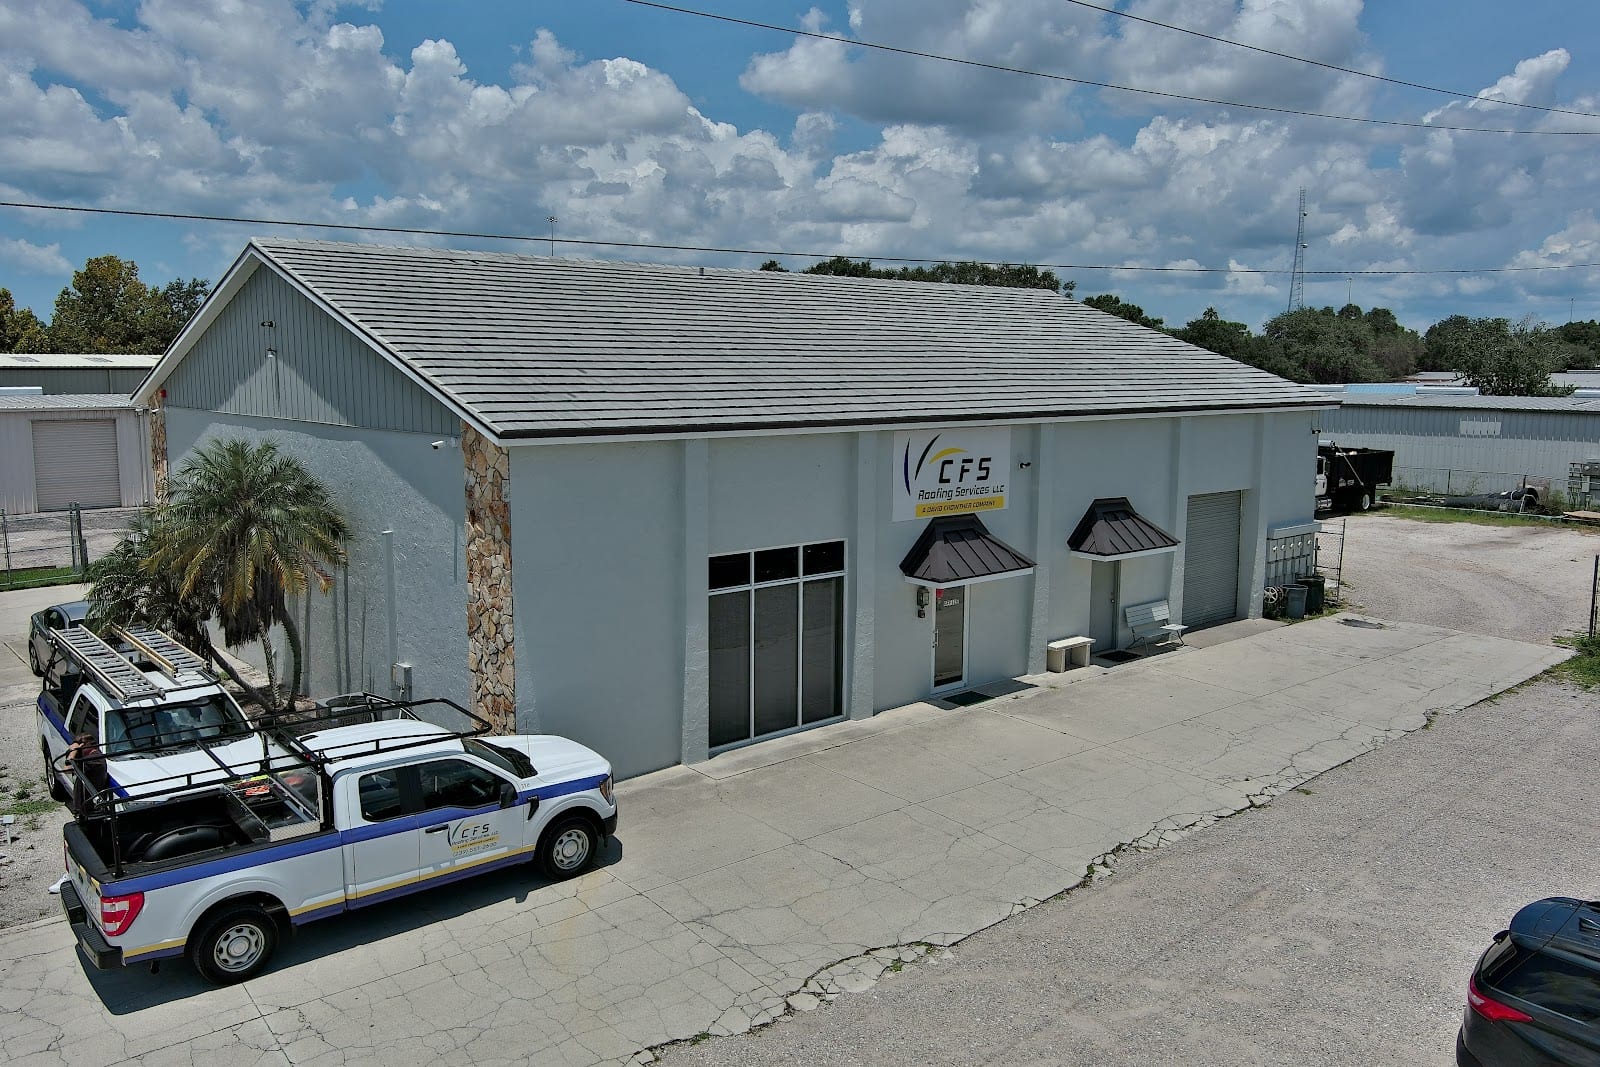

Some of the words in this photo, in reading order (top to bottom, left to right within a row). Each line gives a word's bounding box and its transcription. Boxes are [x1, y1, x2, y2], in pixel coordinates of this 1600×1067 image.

[938, 457, 992, 484] CFS
[918, 487, 953, 501] Roofing
[955, 485, 990, 498] Services
[461, 823, 490, 839] CFS
